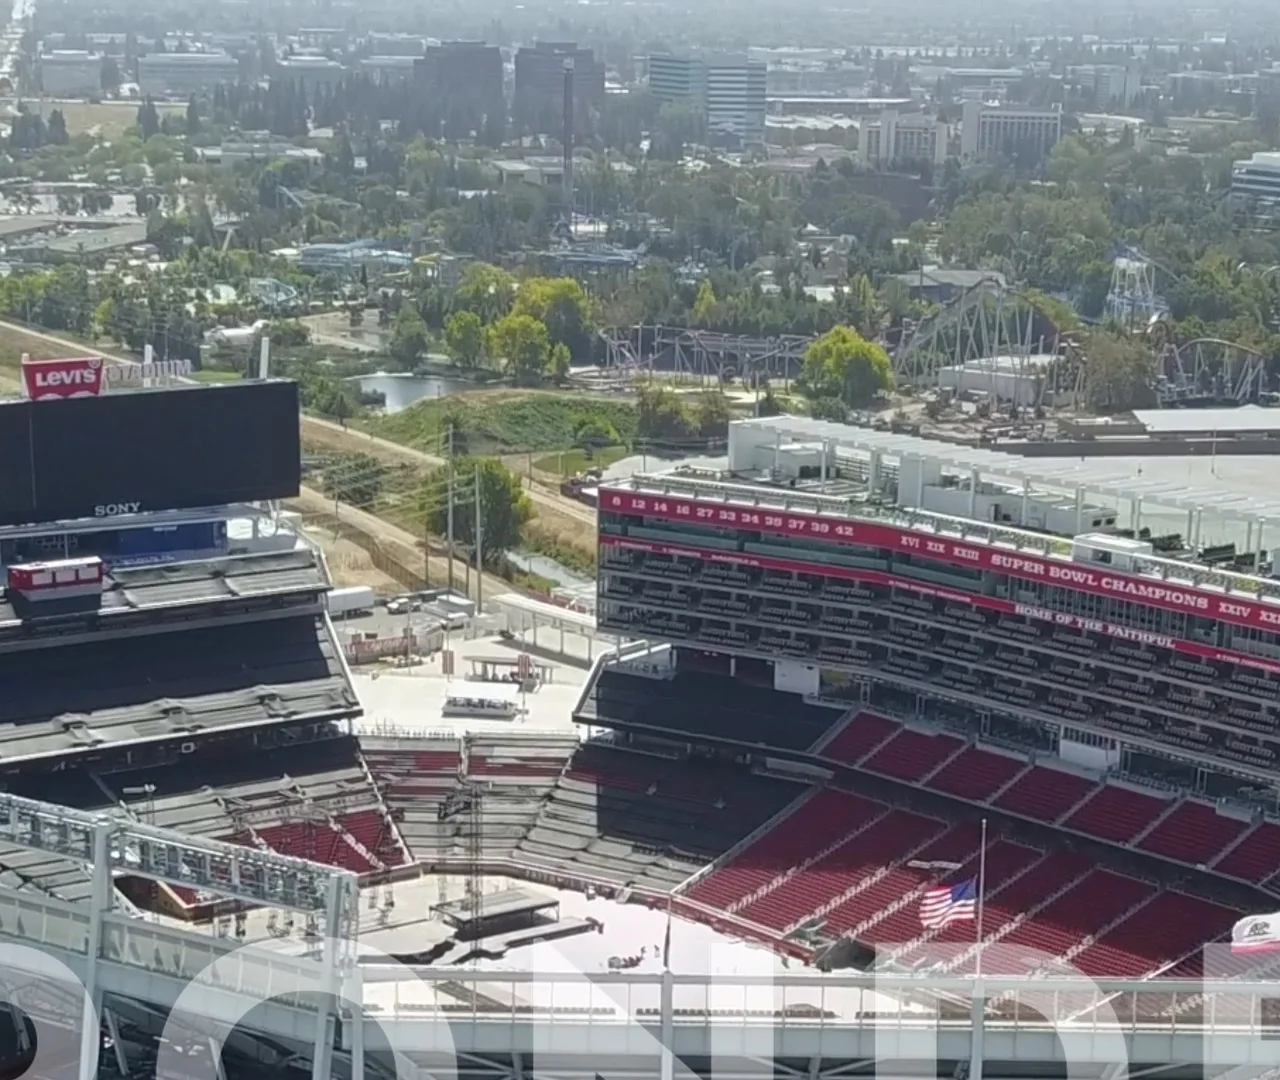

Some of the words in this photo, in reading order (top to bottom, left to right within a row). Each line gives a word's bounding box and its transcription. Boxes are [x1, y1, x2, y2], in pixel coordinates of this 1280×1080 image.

[94, 501, 141, 517] SONY
[697, 507, 713, 518] 27
[835, 525, 854, 536] 42
[900, 536, 920, 549] XVI
[926, 541, 946, 553] XIX
[952, 546, 980, 561] XXIII
[991, 554, 1045, 576] SUPER
[1049, 566, 1098, 587] BOWL
[1100, 576, 1209, 609] CHAMPIONS
[1219, 602, 1252, 618] XXIV
[1015, 604, 1053, 624] HOME
[1055, 614, 1072, 626] OF
[1075, 617, 1104, 632] THE
[1107, 624, 1176, 648] FAITHFUL
